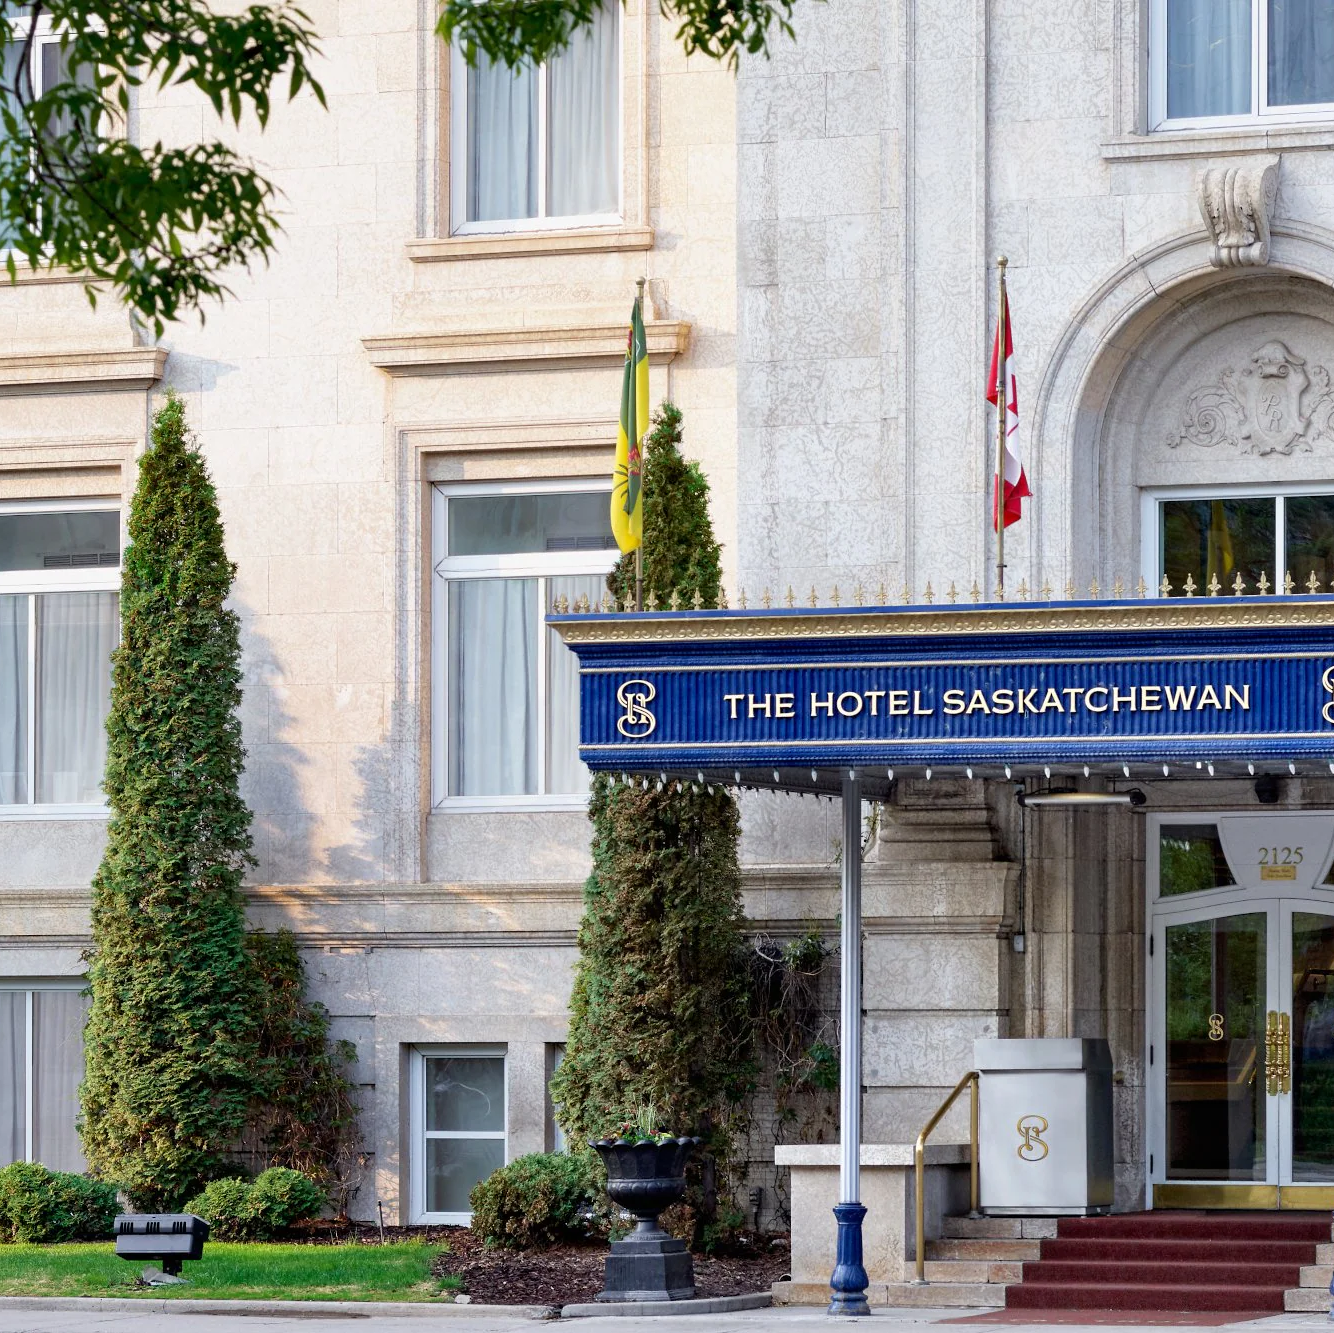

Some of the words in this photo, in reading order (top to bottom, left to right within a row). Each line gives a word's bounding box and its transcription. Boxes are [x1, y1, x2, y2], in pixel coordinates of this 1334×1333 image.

[723, 693, 796, 719] THE
[810, 690, 934, 717] HOTEL
[942, 684, 1250, 715] SASKATCHEWAN
[1258, 847, 1304, 865] 2125
